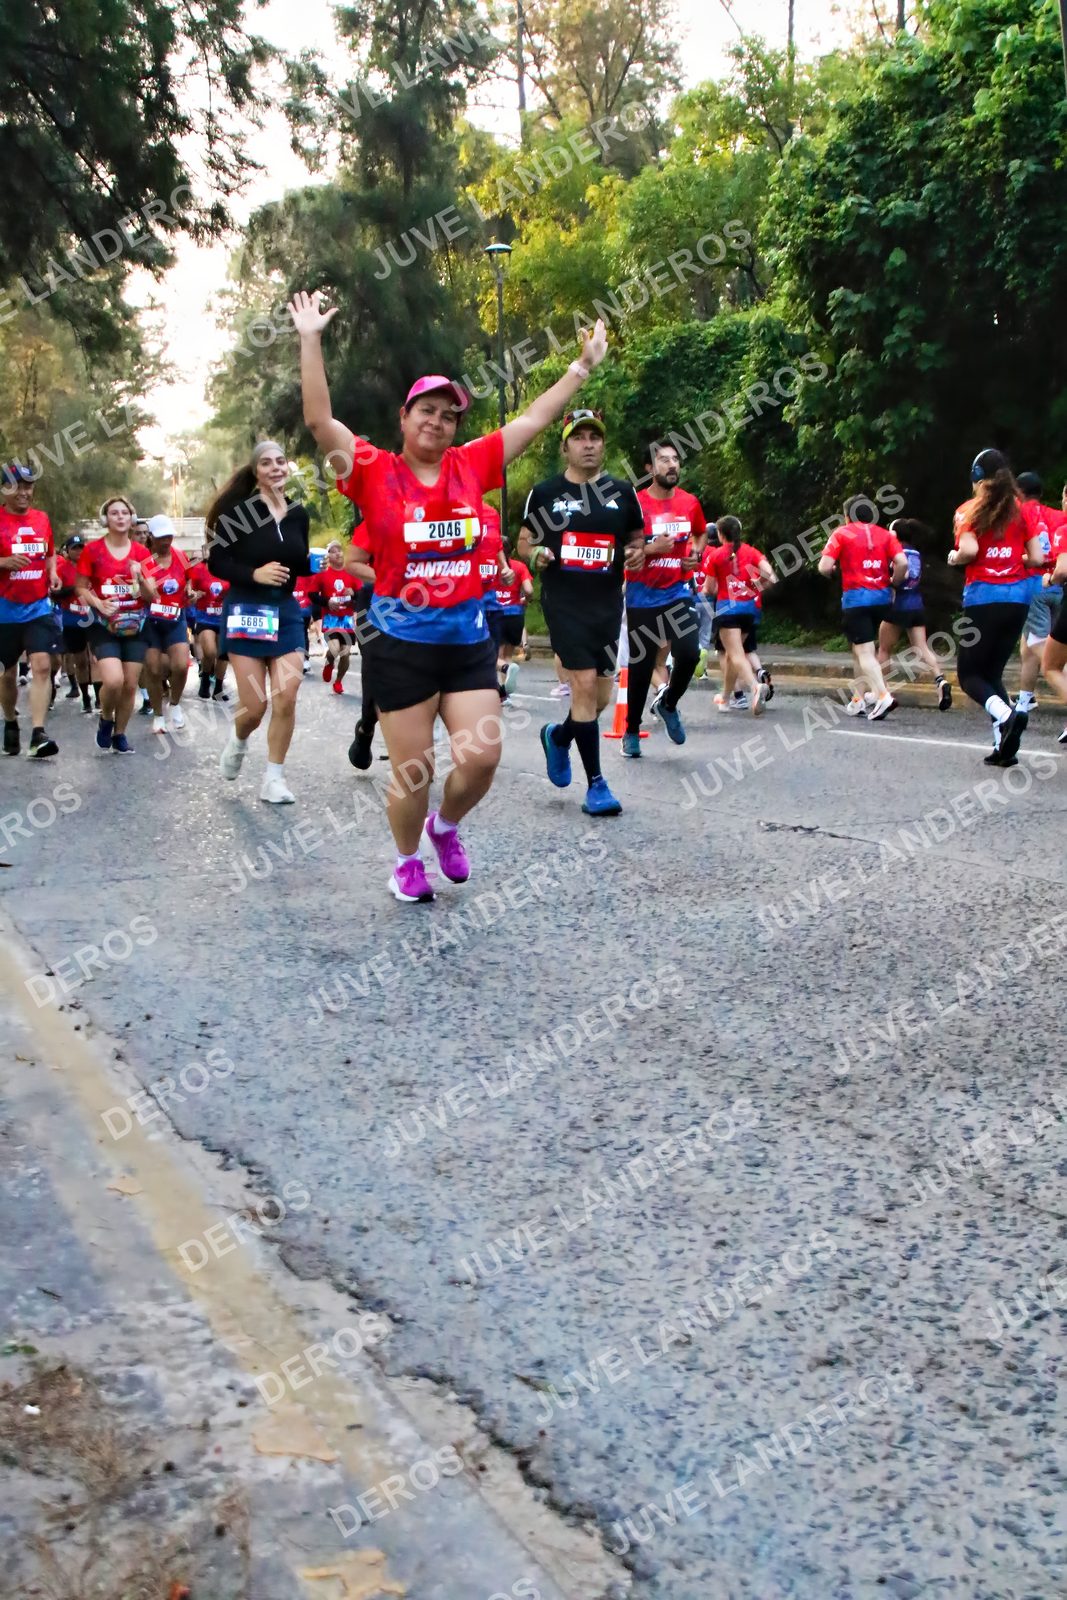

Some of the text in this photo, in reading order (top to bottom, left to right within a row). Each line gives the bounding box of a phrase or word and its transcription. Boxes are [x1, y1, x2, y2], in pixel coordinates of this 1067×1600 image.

[428, 521, 462, 539] 2046
[576, 547, 602, 560] 17619
[986, 546, 1012, 558] 20-26
[405, 560, 471, 579] SANTIAGO
[240, 616, 264, 627] 5685
